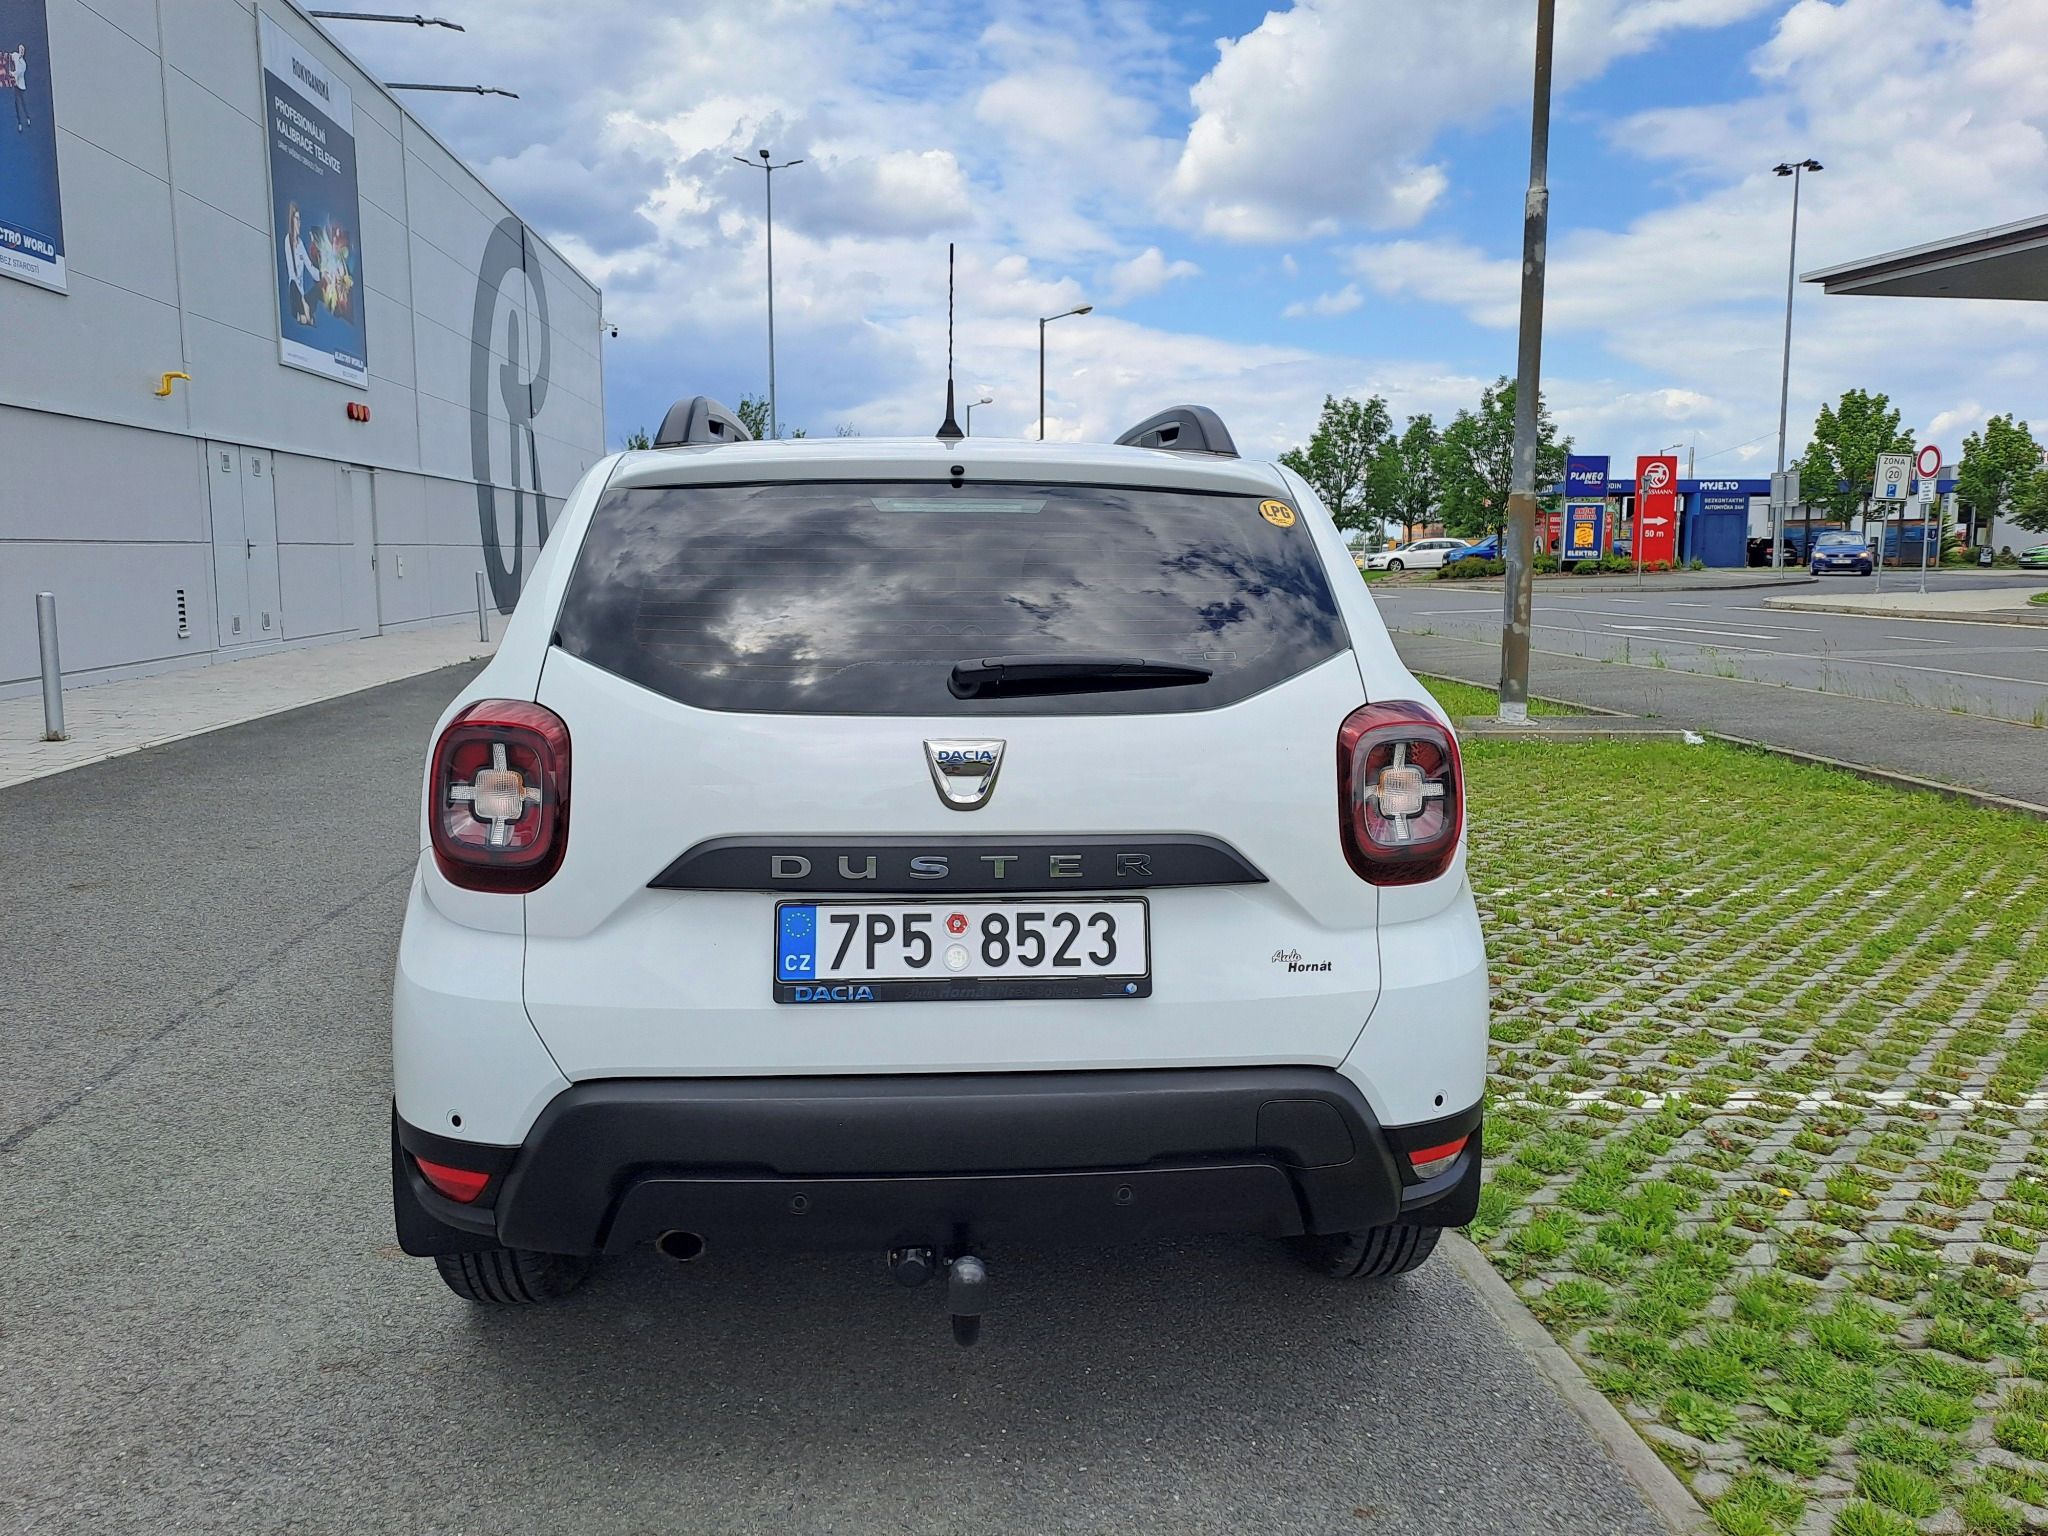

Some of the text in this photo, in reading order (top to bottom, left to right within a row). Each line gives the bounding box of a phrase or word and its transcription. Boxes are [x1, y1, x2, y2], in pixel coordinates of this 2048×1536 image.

[291, 56, 330, 102] ROKYCANSKÁ
[274, 96, 327, 145] PROFESIONÁLNÍ
[276, 117, 314, 155] KALIBRACE
[313, 143, 342, 174] TELEVIZE
[23, 235, 55, 257] WORLD
[13, 258, 40, 274] STAROSTÍ
[1570, 471, 1604, 480] PLANEO
[1888, 470, 1900, 479] 20
[1699, 481, 1739, 490] MYJE.TO
[1263, 504, 1291, 519] LPG
[938, 750, 993, 761] DACIA
[770, 853, 1153, 879] DUSTER
[829, 911, 1118, 970] 7P5 8523
[784, 954, 811, 972] CZ
[1287, 960, 1332, 973] Hornát
[794, 986, 874, 1001] DACIA
